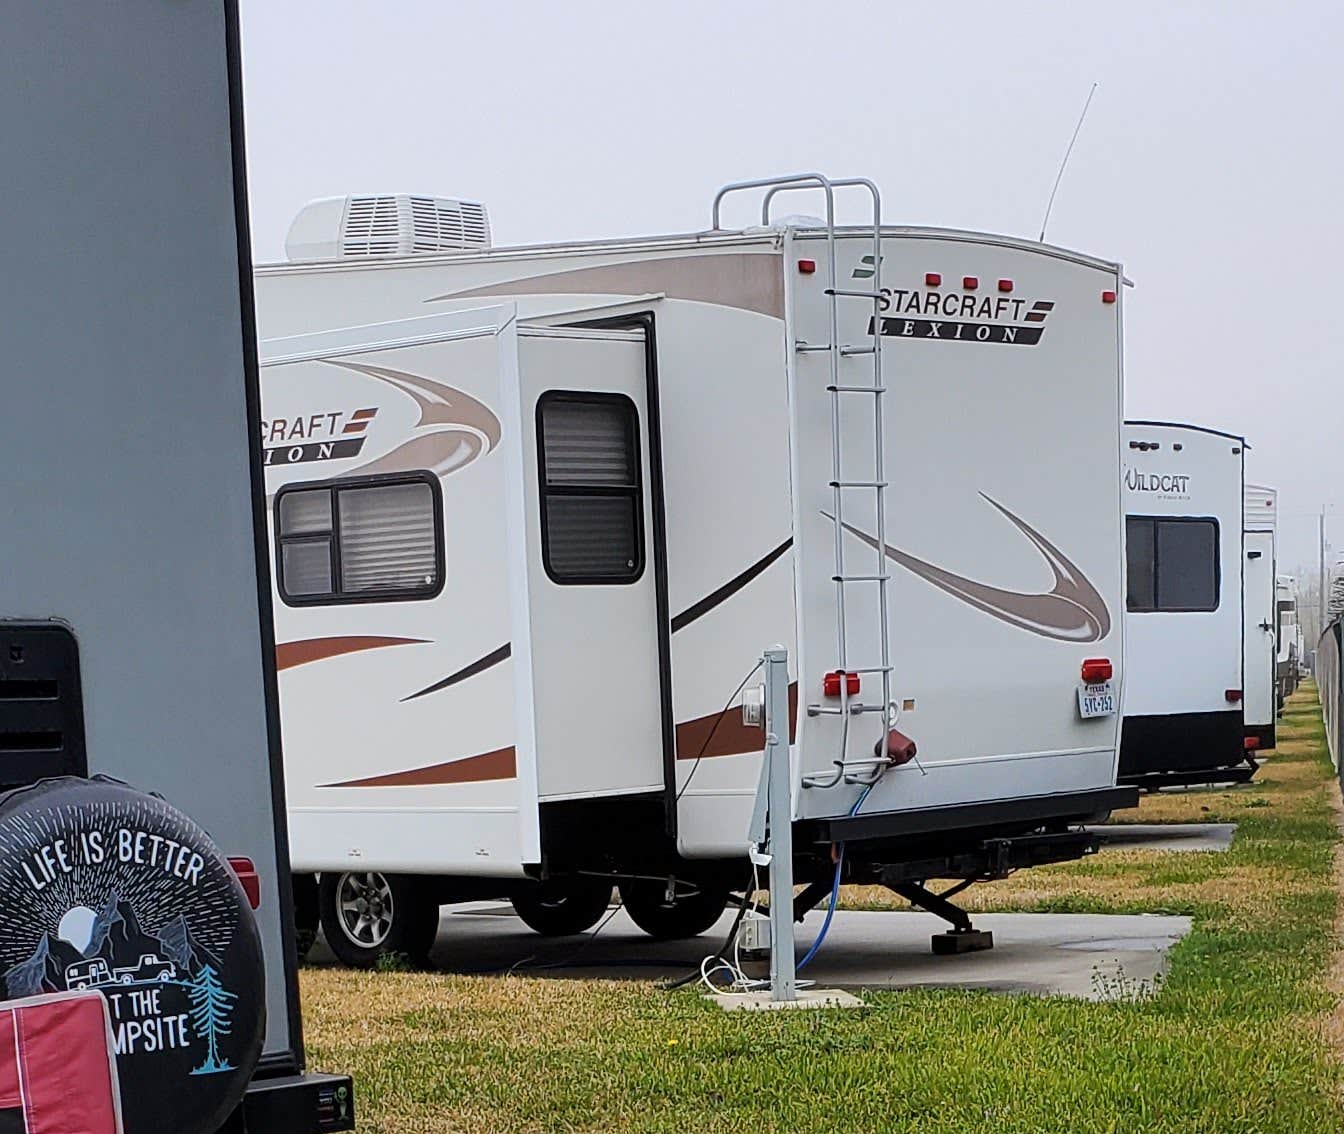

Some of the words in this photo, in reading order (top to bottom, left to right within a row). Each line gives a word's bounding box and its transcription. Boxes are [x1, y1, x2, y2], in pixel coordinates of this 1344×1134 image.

[879, 288, 1026, 321] STARCRAFT
[880, 321, 1019, 343] LEXION
[260, 411, 344, 442] CRAFT
[264, 443, 336, 465] ION
[1124, 467, 1190, 493] WILDCAT
[21, 840, 72, 890] LIFE
[81, 831, 105, 865] IS
[118, 828, 204, 886] BETTER
[109, 993, 122, 1019] T
[128, 989, 162, 1017] THE
[115, 1013, 190, 1055] MPSITE
